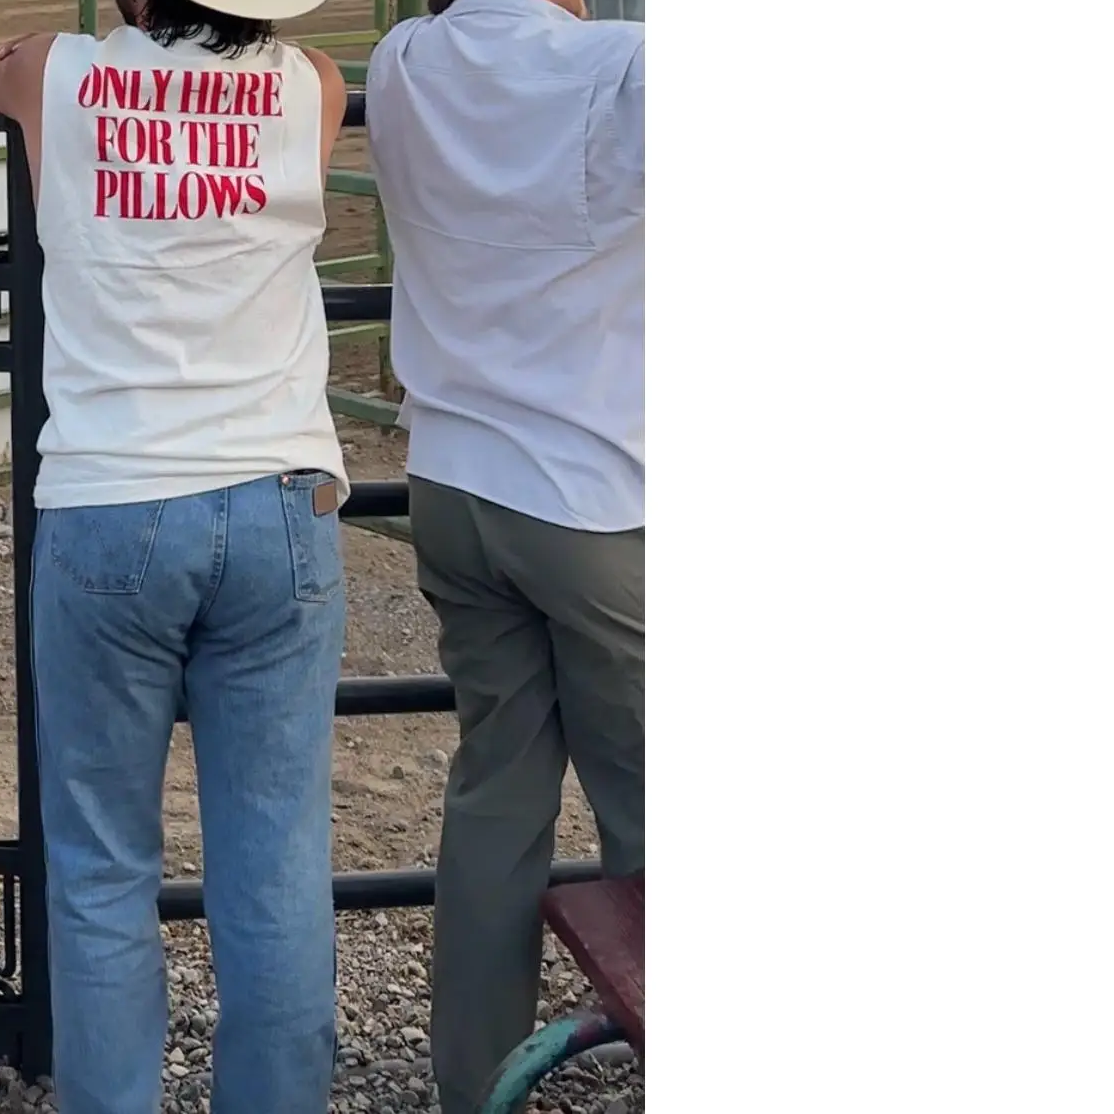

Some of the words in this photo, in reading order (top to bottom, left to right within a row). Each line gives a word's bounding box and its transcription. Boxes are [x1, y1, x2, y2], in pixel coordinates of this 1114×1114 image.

[78, 64, 173, 113] ONLY
[179, 71, 283, 117] HERE
[95, 116, 174, 165] FOR
[180, 121, 259, 168] THE
[94, 169, 267, 220] PILLOWS
